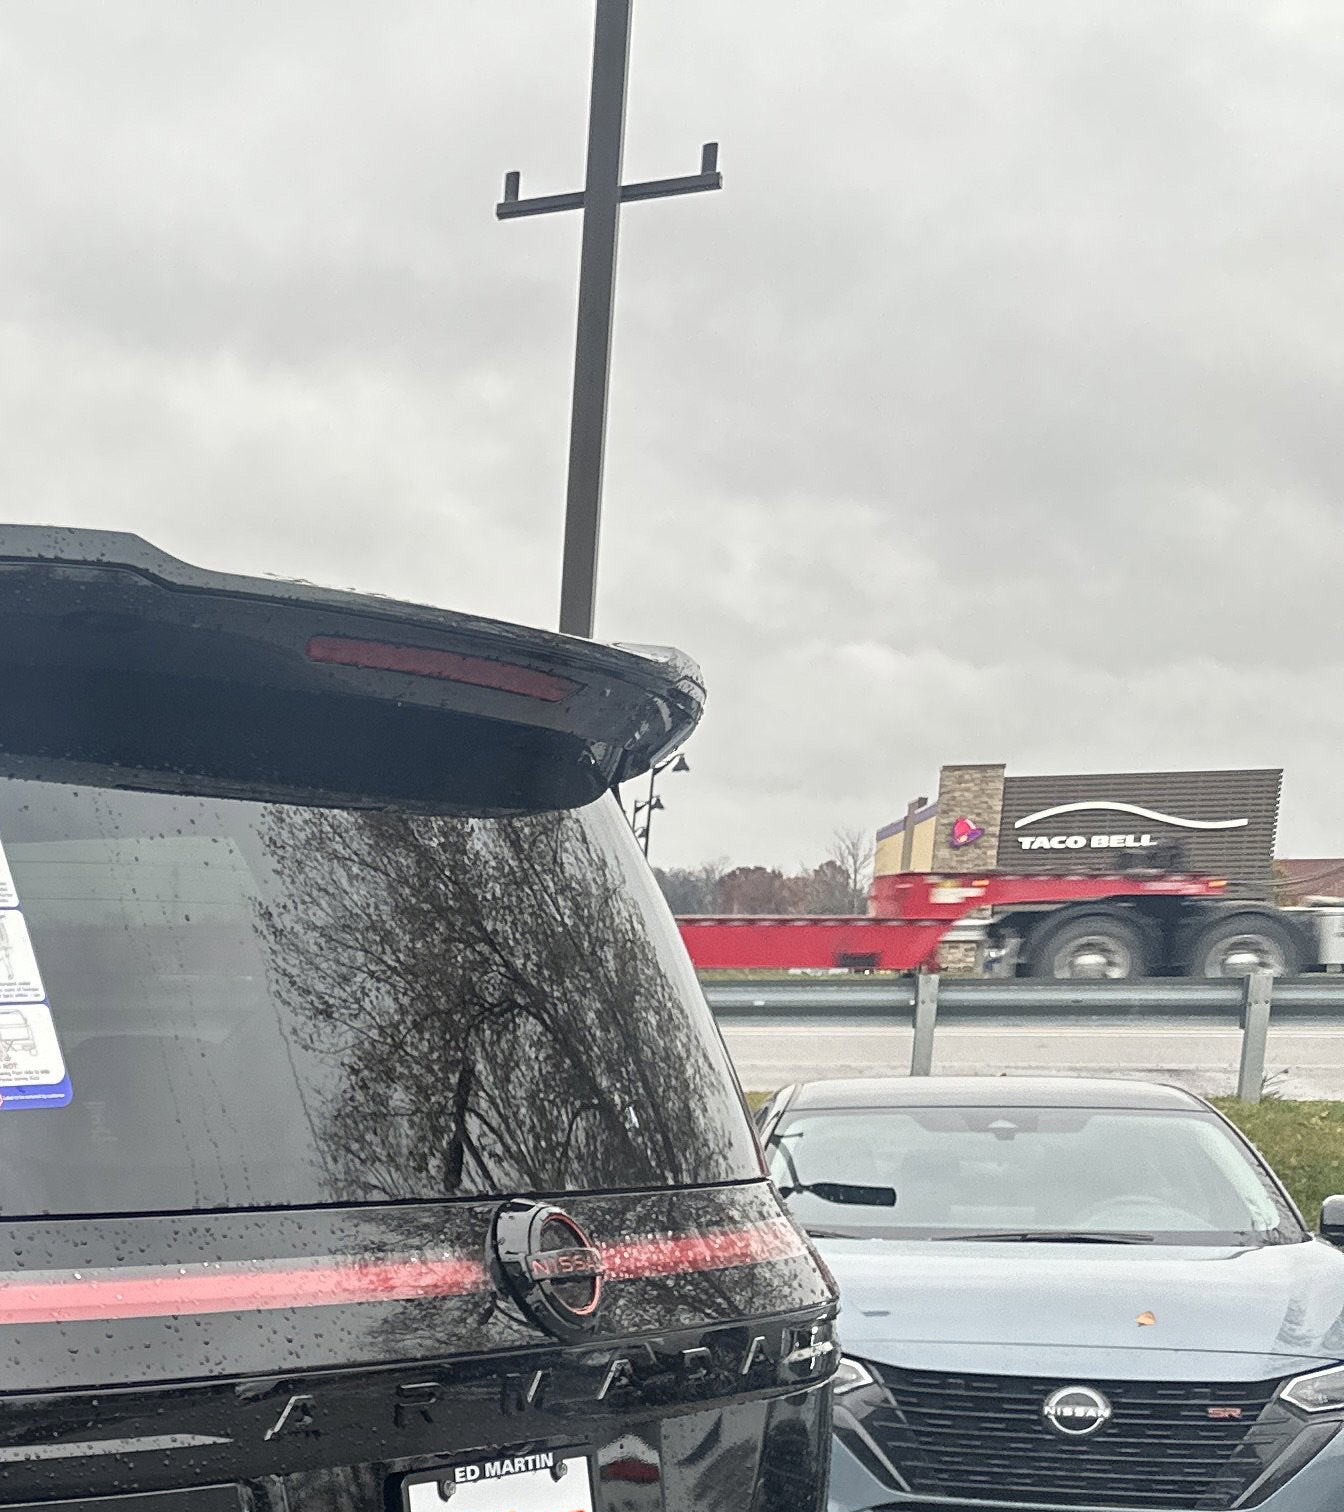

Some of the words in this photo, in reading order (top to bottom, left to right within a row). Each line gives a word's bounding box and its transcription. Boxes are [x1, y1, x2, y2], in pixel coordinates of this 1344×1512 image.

[1018, 835, 1087, 850] TACO
[1090, 834, 1158, 848] BELL
[1043, 1404, 1111, 1419] NISSAN
[1207, 1407, 1242, 1419] SR
[455, 1465, 480, 1483] ED
[485, 1452, 554, 1478] MARTIN
